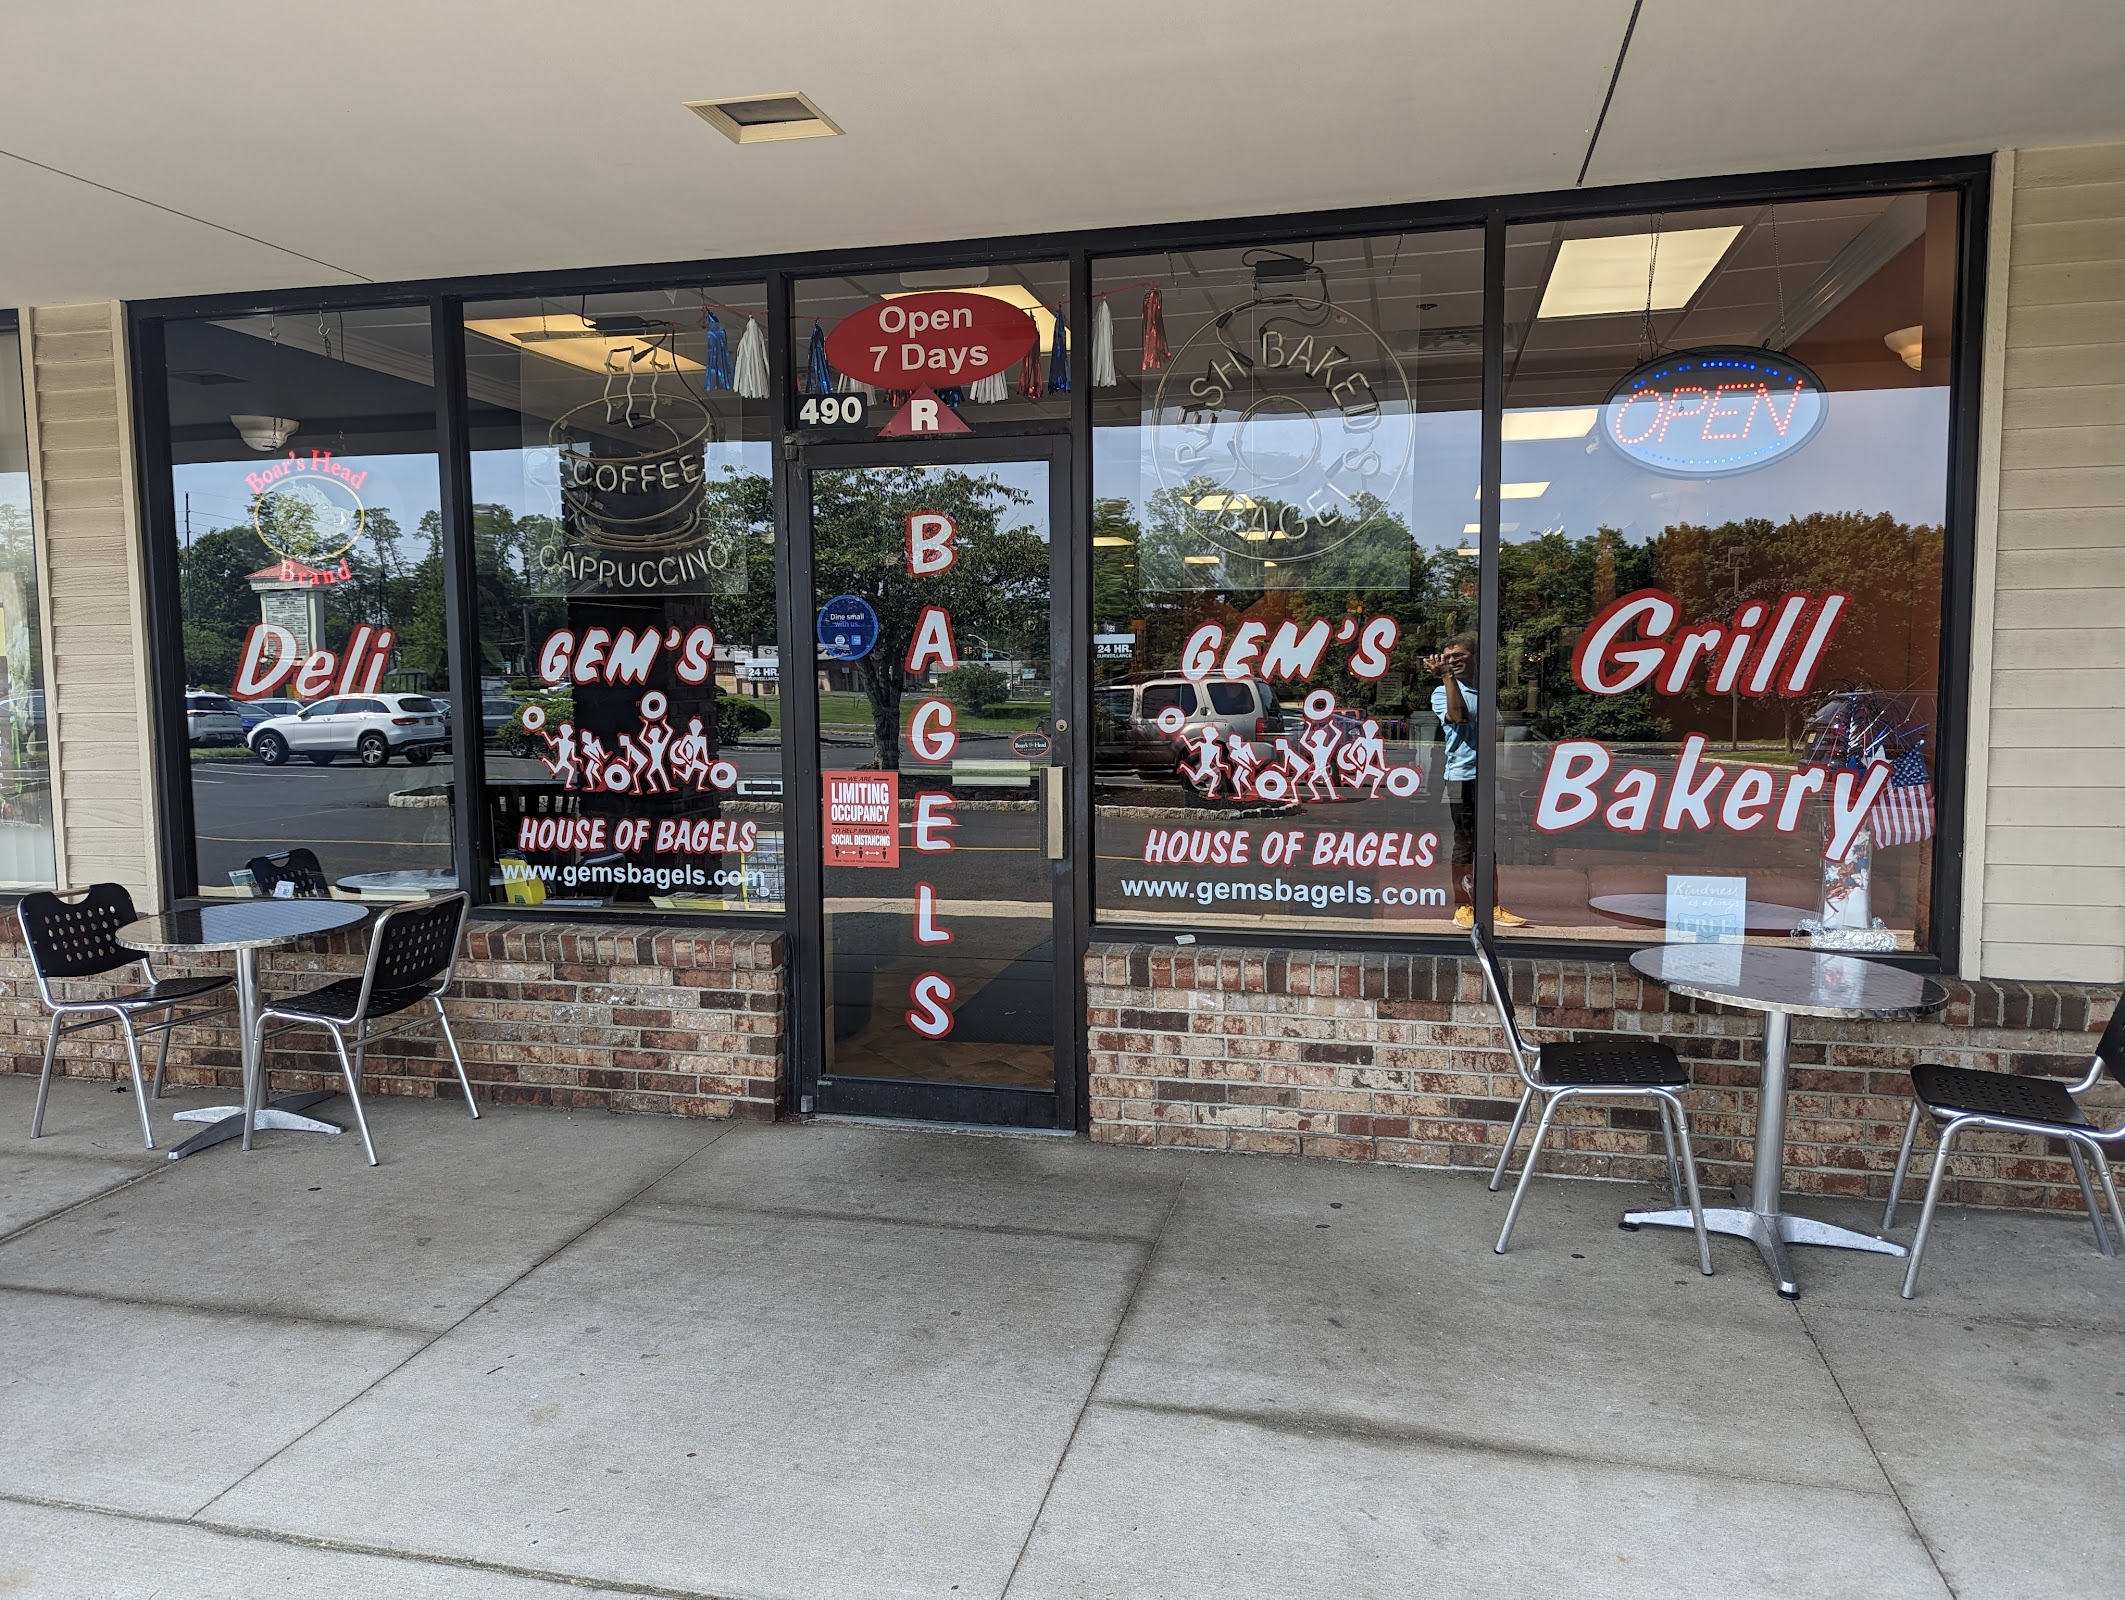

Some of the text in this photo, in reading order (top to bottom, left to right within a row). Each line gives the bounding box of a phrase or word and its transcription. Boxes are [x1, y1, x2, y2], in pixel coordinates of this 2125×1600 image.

[878, 305, 973, 338] Open
[869, 344, 989, 375] 7 Days
[1262, 330, 1381, 433] BAKED
[799, 396, 863, 425] 490
[911, 399, 939, 431] R
[1616, 379, 1803, 444] OPEN
[244, 449, 367, 495] Boar's Head
[573, 454, 701, 494] COFFEE
[279, 557, 352, 585] Brand
[539, 544, 729, 588] CAPPUCCINO
[539, 625, 715, 686] GEM'S
[1097, 644, 1132, 653] 24 HR.
[1179, 615, 1399, 683] GEM'S
[1571, 588, 1851, 698] Grill
[232, 623, 395, 700] Deli
[748, 668, 779, 676] 24 HR.
[906, 510, 959, 1039] BAGELS
[831, 782, 889, 804] LIMITING
[1534, 733, 1893, 863] Bakery
[831, 804, 889, 822] OCCUPANCY
[519, 817, 758, 854] HOUSE OF BAGELS
[831, 834, 890, 846] SOCIAL DISTANCING
[1143, 829, 1439, 869] HOUSE OF BAGELS
[501, 863, 765, 889] www.gemsbagels.com
[1121, 878, 1446, 908] www.gemsbagels.com
[1673, 880, 1739, 899] Kindness
